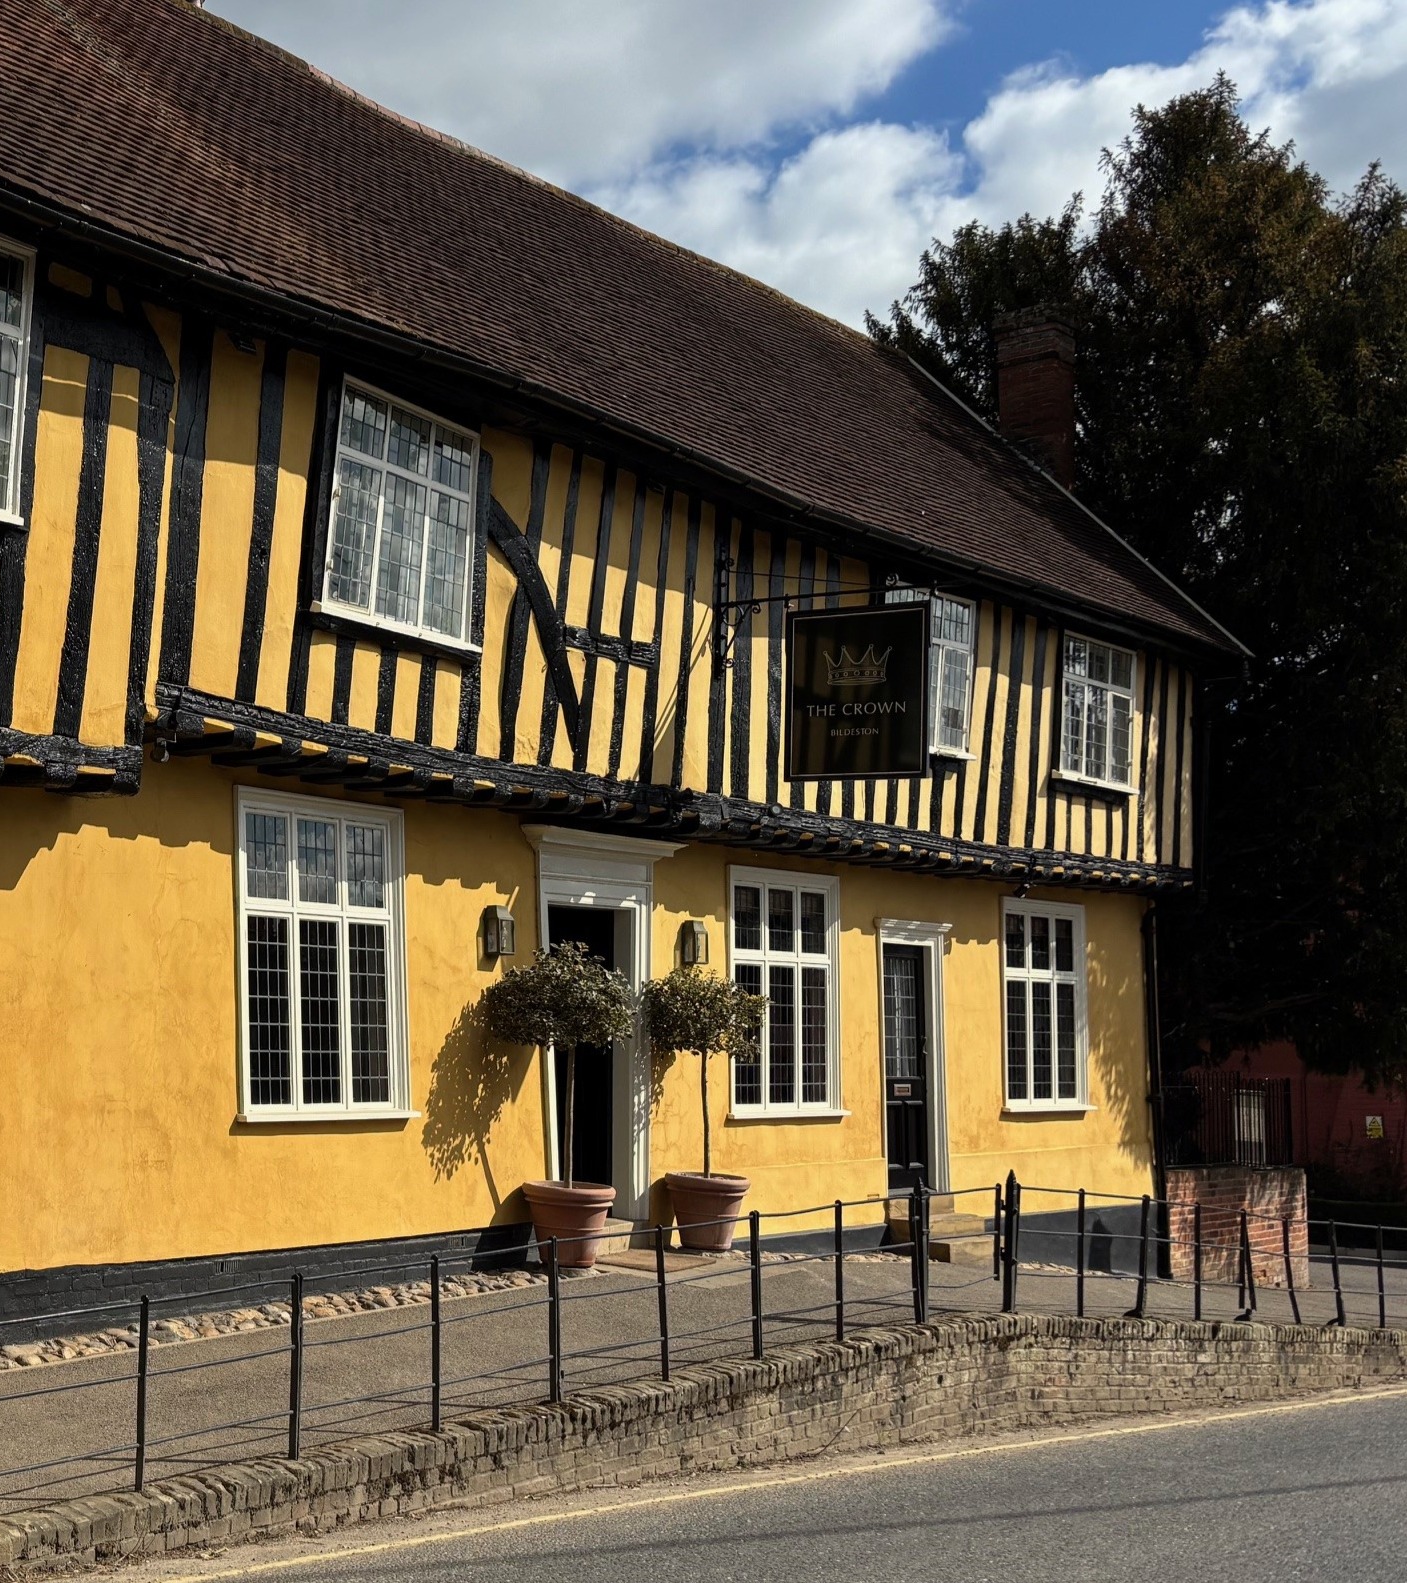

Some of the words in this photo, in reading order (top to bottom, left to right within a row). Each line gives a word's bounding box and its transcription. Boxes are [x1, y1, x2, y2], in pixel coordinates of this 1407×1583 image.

[807, 704, 836, 717] THE
[842, 701, 906, 716] CROWN
[830, 728, 879, 736] BILDESTON
